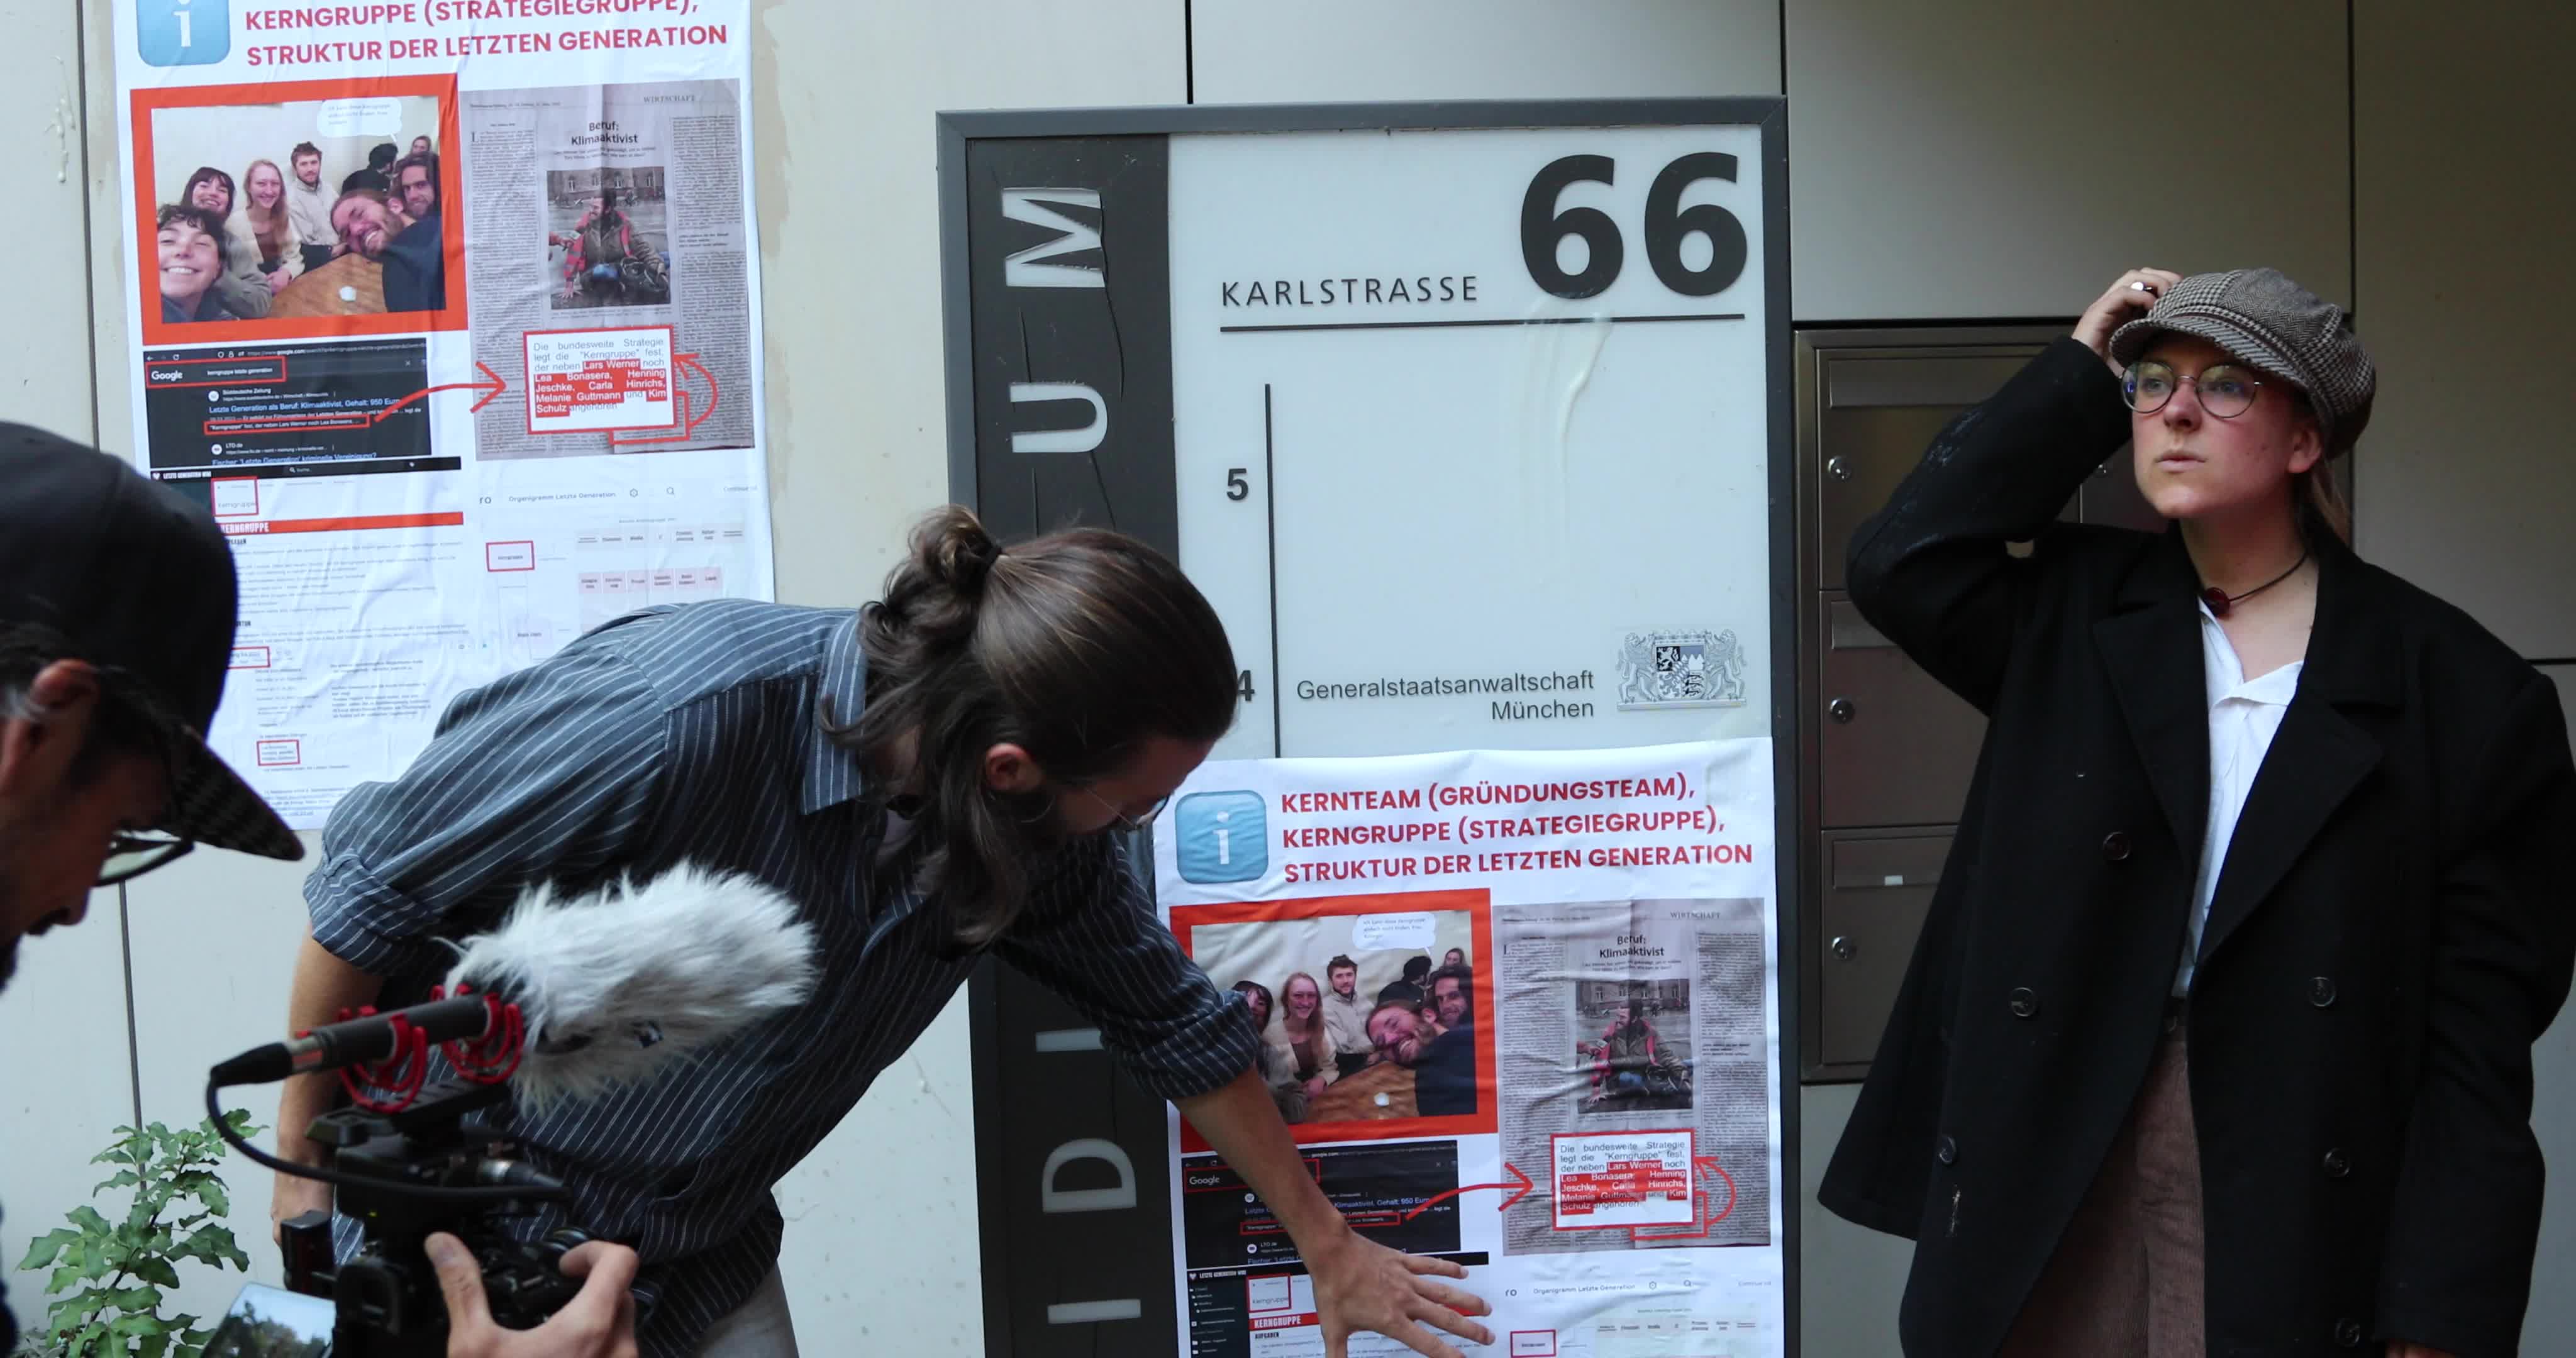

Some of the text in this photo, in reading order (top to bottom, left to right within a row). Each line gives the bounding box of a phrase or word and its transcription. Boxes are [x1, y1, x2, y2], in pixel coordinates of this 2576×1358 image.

[246, 3, 416, 30] KERNGRUPPE
[247, 25, 727, 66] STRUKTUR DER LETZTEN GENERATION
[589, 121, 619, 131] Beruf:
[571, 133, 638, 146] Klimaaktivist
[1521, 151, 1747, 300] 66
[1222, 275, 1479, 307] KARLSTRASSE
[533, 338, 663, 351] Die bundesweite Strategie
[533, 352, 550, 363] legt
[555, 351, 569, 361] die
[535, 358, 664, 372] der neben Lars Werner noch
[151, 370, 183, 382] Google
[535, 373, 552, 383] Lea
[628, 368, 665, 379] Henning
[588, 382, 613, 390] Carla
[536, 389, 667, 403] Melanie Guttmann und Kim
[209, 406, 230, 414] Letzte
[231, 404, 267, 414] Generation
[536, 404, 567, 414] Schulz
[1226, 468, 1249, 501] 5
[1296, 670, 1595, 701] Generalstaatsanwaltschaft
[1491, 699, 1595, 721] München
[1282, 789, 1421, 813] KERNTEAM
[1428, 772, 1695, 812] (GRÜNDUNGSTEAM),
[1283, 805, 1725, 848] KERNGRUPPE (STRATEGIEGRUPPE),
[1285, 844, 1753, 883] STRUKTUR DER LETZTEN GENERATION
[1617, 934, 1646, 945] Beruf:
[1599, 946, 1665, 959] Klimaaktivist
[1560, 1141, 1685, 1153] Die bundesweite Strategie
[1560, 1155, 1576, 1164] legt
[1581, 1154, 1594, 1162] die
[1560, 1160, 1686, 1173] der neben Lars Werner noch
[1189, 1174, 1220, 1185] Google
[1560, 1174, 1577, 1183] Lea
[1650, 1170, 1686, 1179] Henning
[1561, 1193, 1596, 1202] Melanie
[1669, 1189, 1687, 1197] Kim
[1562, 1201, 1591, 1211] Schulz
[1533, 1286, 1577, 1295] Organigramm
[1254, 1315, 1302, 1328] KERNGRUPPE
